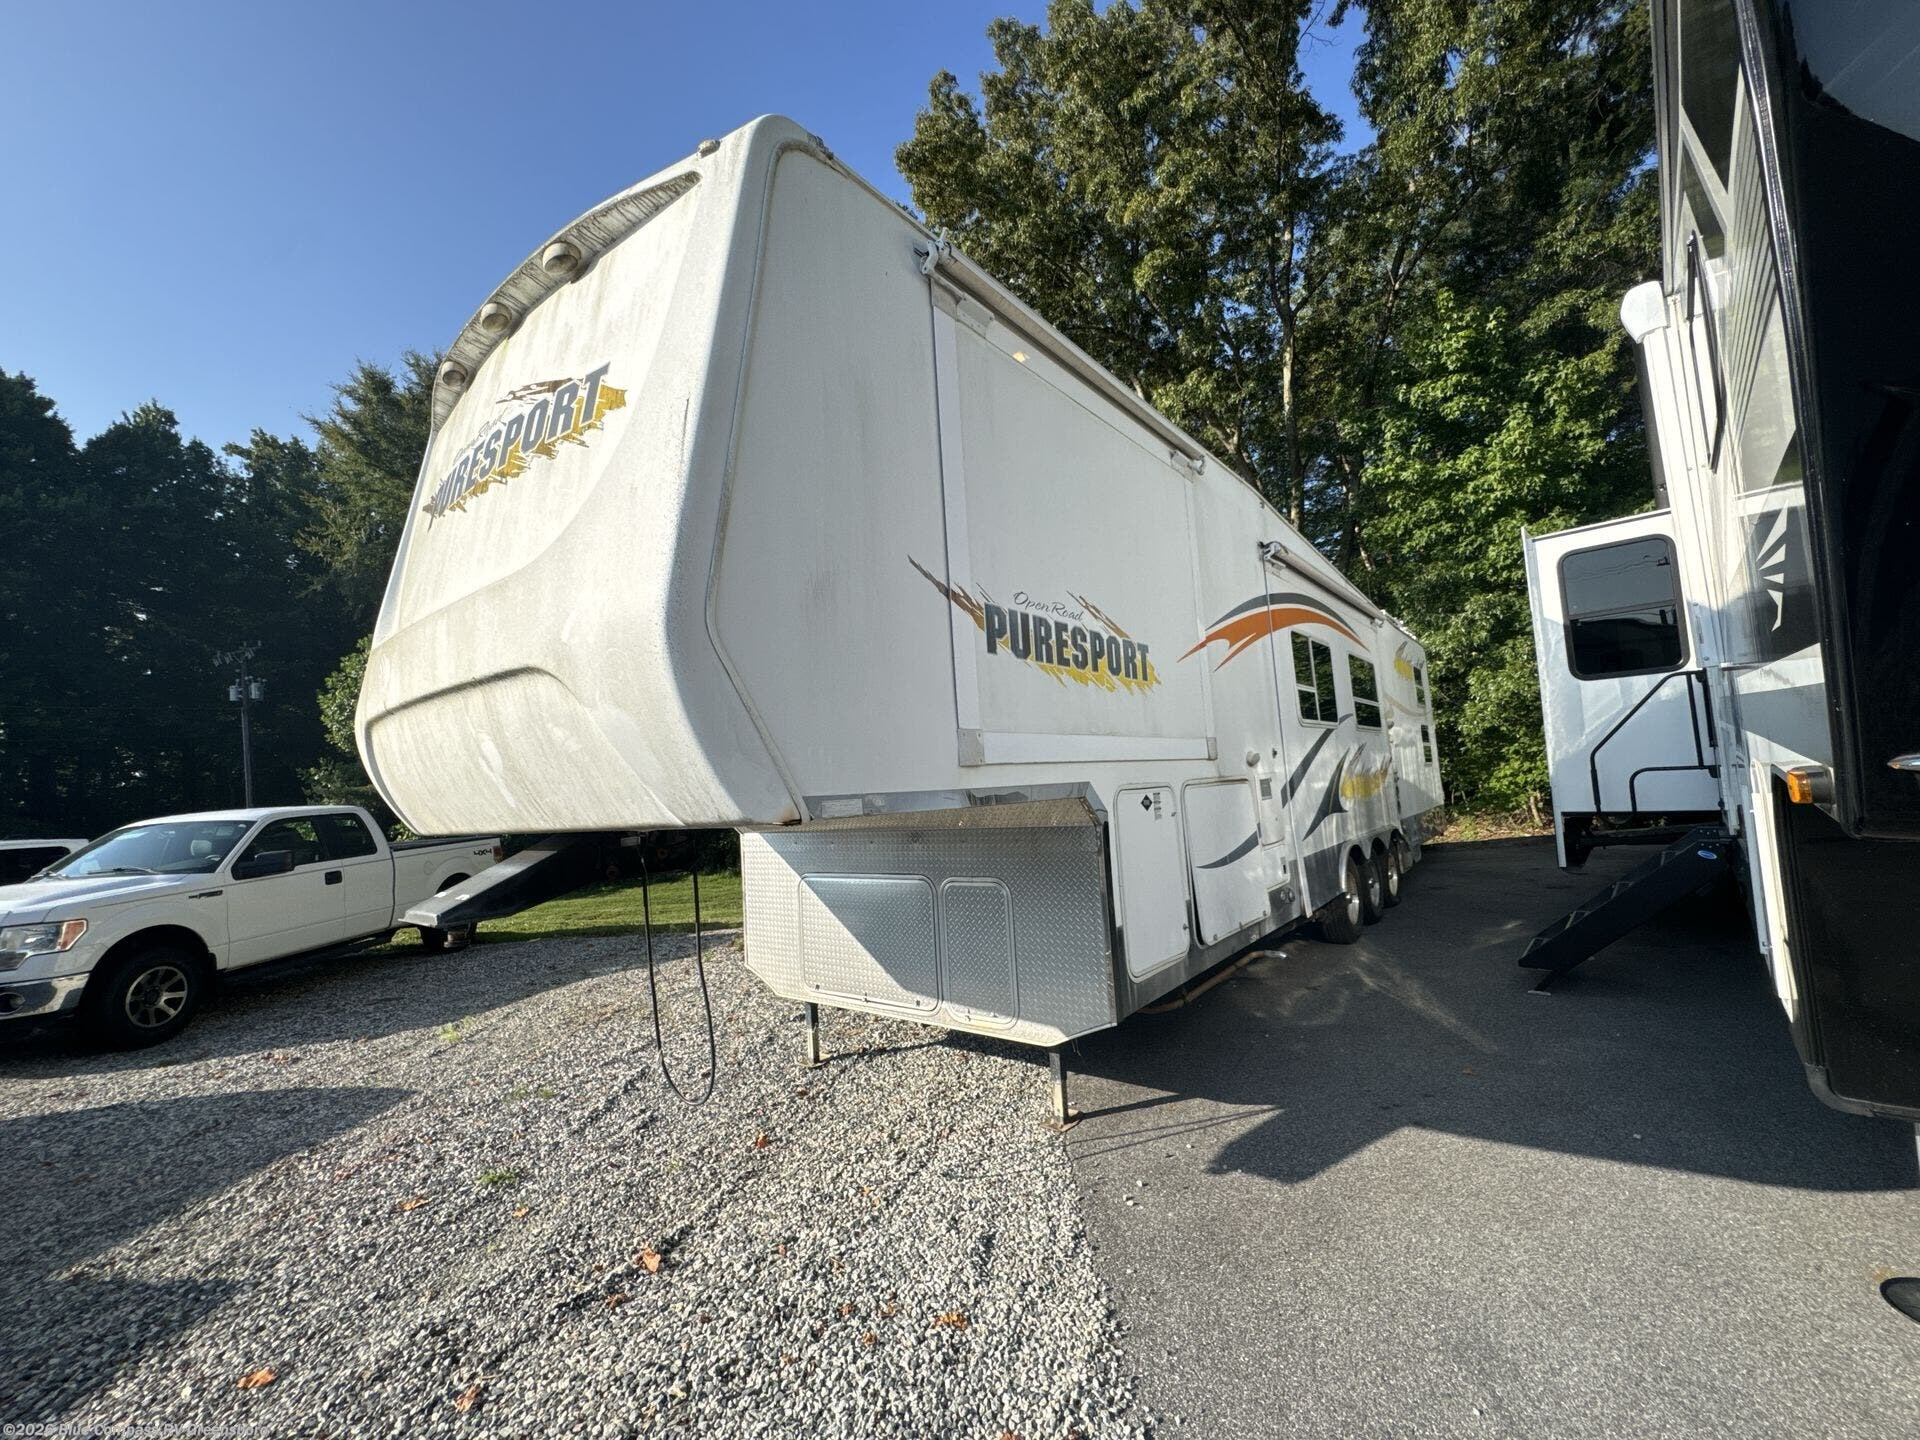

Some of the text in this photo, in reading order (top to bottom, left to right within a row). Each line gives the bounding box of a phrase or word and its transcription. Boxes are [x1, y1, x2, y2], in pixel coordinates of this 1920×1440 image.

[1013, 591, 1084, 620] Open Road
[984, 602, 1149, 682] PURESPORT
